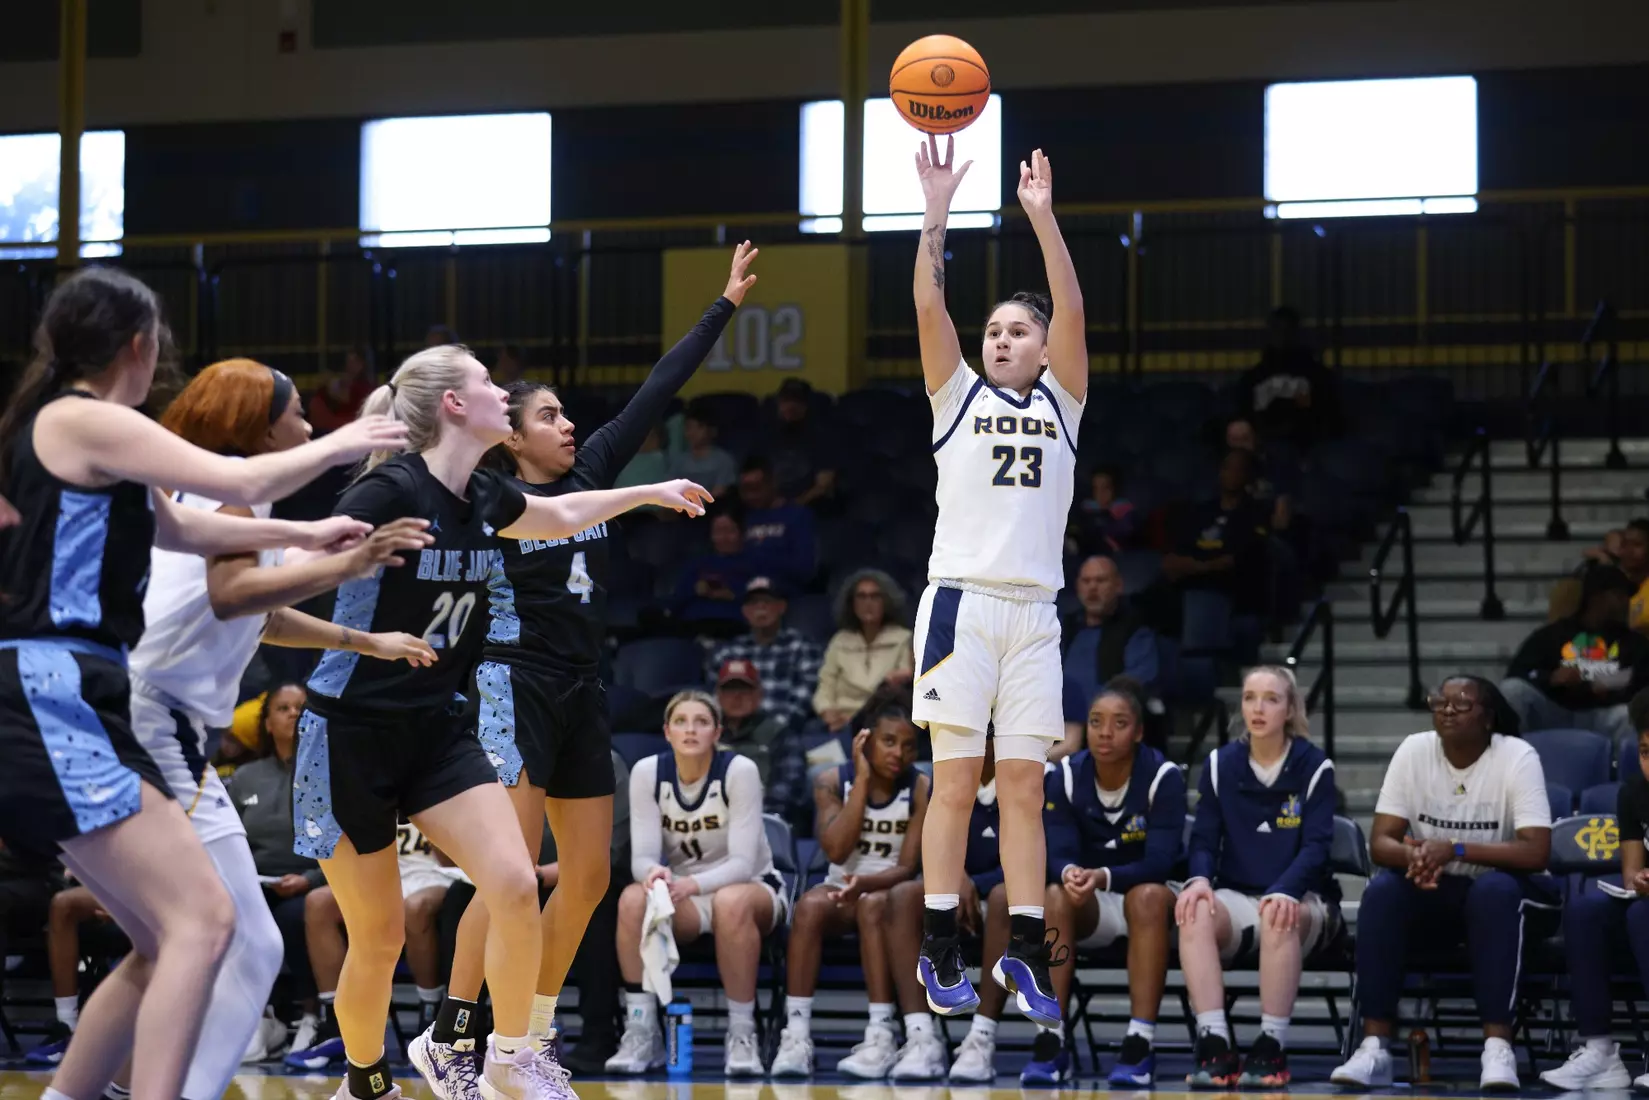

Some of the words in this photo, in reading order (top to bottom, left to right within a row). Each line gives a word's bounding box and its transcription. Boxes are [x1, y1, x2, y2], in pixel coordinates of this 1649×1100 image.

[908, 99, 975, 120] Wilson
[974, 416, 1058, 440] ROOS
[992, 445, 1043, 488] 23
[416, 549, 463, 582] BLUE
[565, 550, 594, 604] 4
[422, 591, 476, 649] 20
[862, 818, 910, 835] OOS
[397, 828, 431, 857] 24
